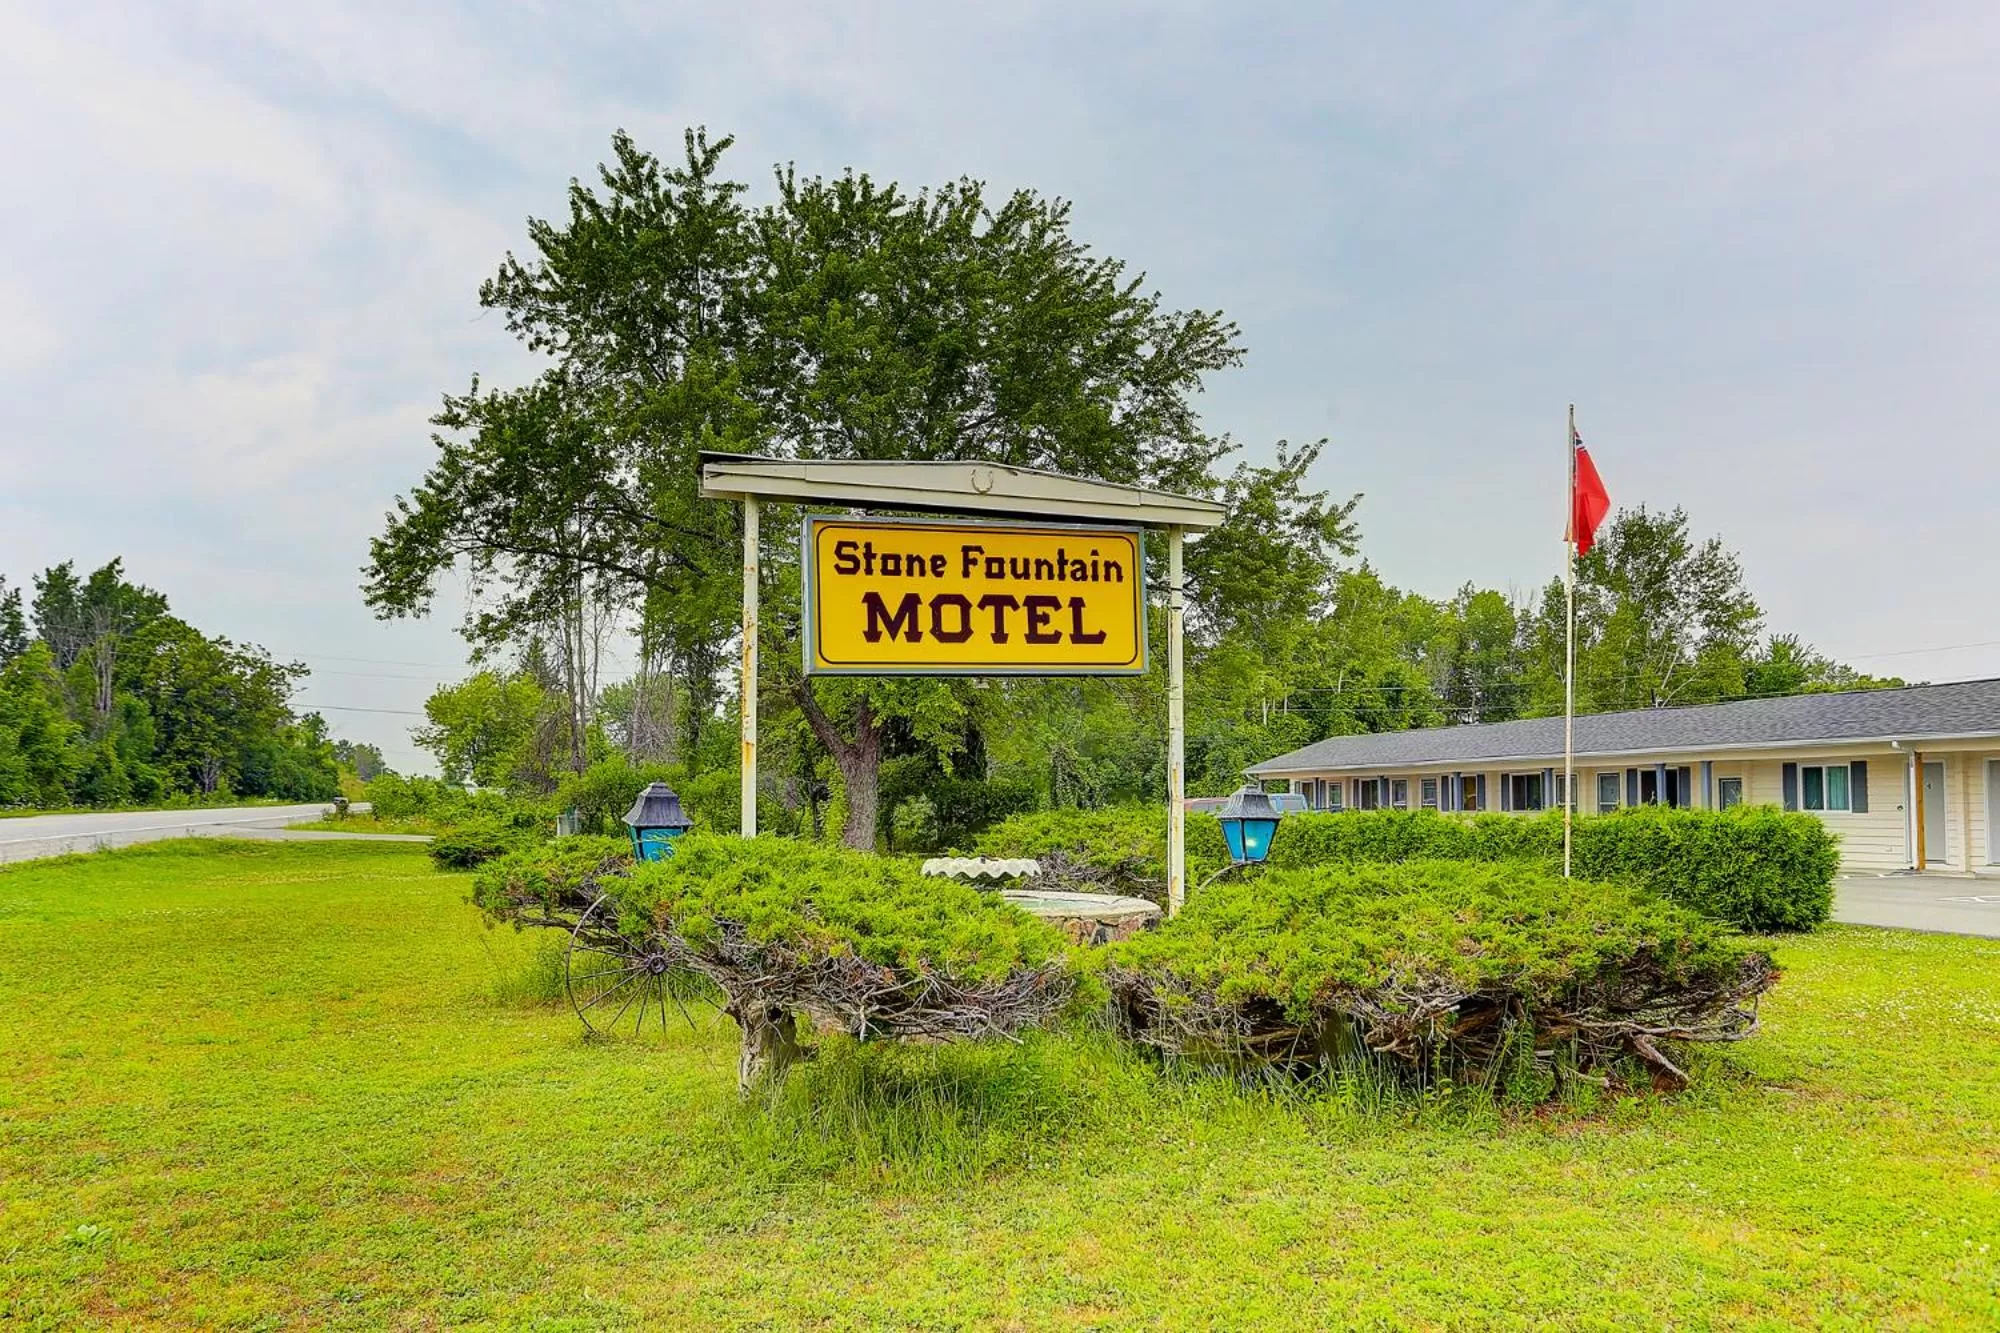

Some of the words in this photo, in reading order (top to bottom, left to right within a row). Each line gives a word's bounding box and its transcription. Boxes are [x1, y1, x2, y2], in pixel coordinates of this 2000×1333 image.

[833, 540, 947, 578] Stone
[961, 544, 1124, 583] Fountain
[861, 591, 1107, 645] MOTEL
